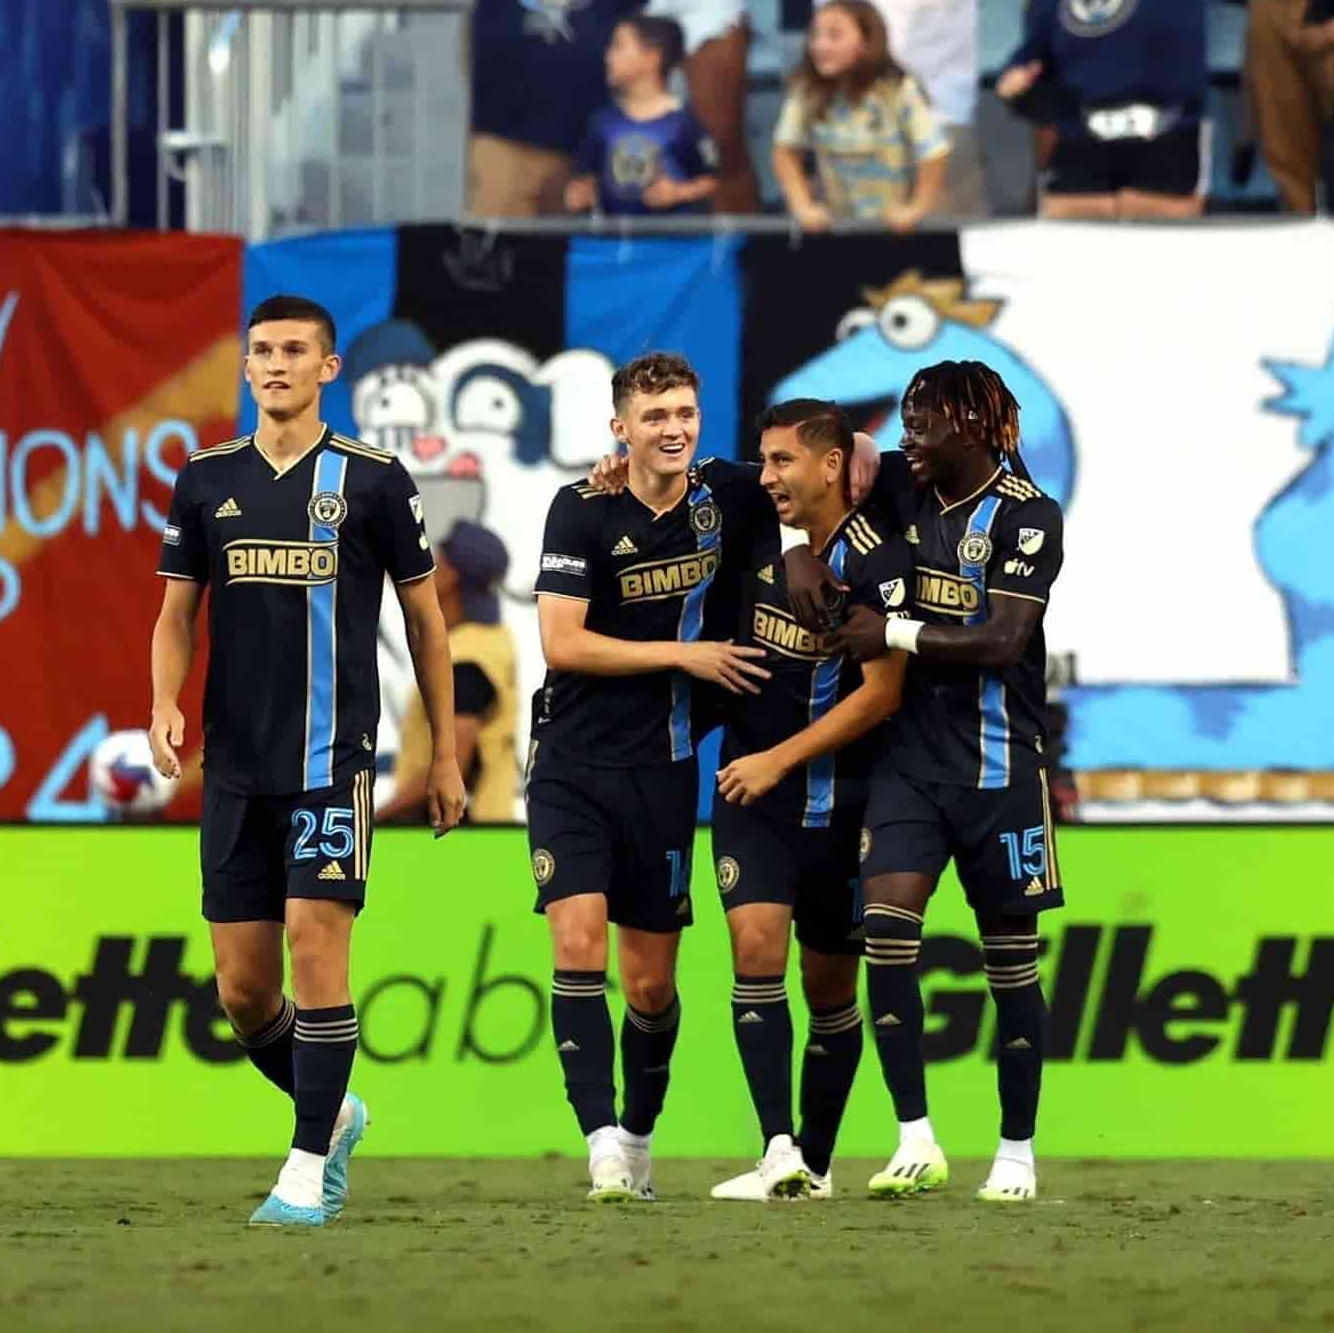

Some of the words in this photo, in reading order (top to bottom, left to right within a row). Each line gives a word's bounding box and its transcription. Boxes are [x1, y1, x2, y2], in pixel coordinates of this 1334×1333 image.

[227, 548, 335, 577] BIMBO
[621, 554, 717, 599] BIMBO
[753, 609, 823, 652] BIMB
[291, 807, 354, 859] 25
[999, 826, 1045, 880] 15
[357, 922, 549, 1064] ab
